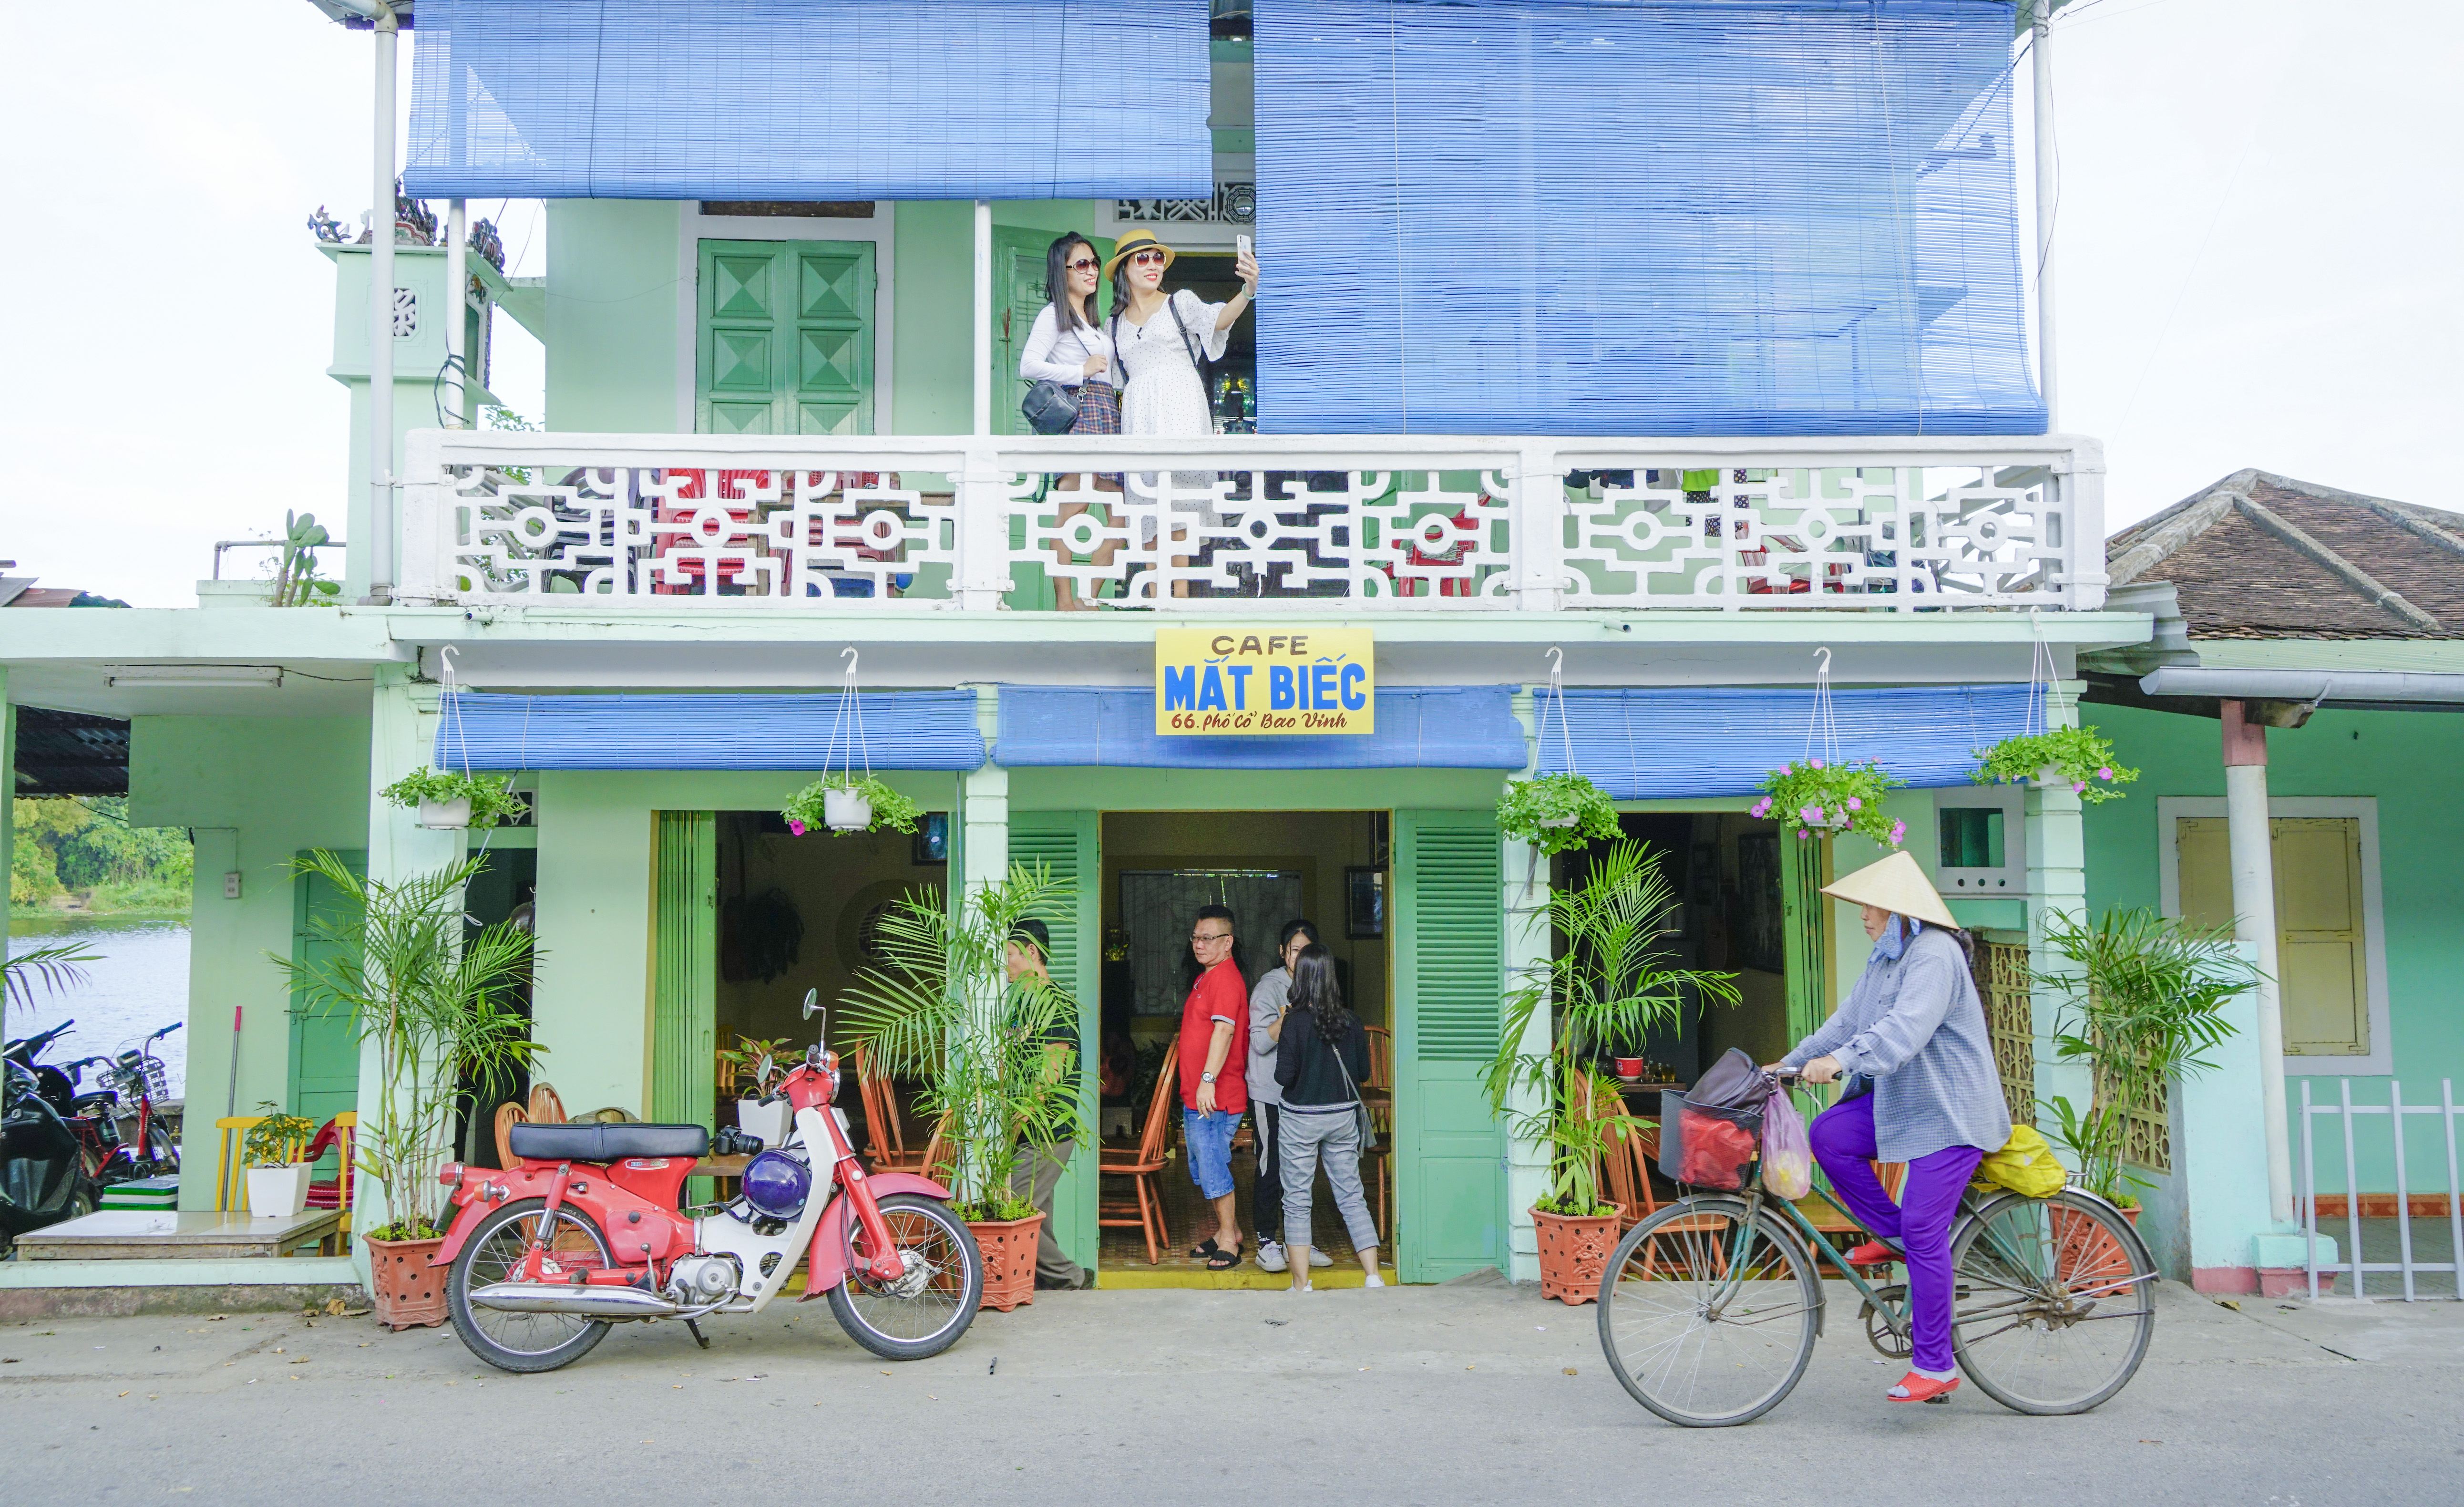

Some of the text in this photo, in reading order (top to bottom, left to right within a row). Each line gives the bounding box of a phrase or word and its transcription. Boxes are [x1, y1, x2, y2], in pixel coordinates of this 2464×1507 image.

[1211, 635, 1308, 656] CAFE
[1164, 653, 1366, 711] MẮT BIẾC
[1260, 713, 1296, 729] Bao
[1301, 712, 1347, 728] Vinh
